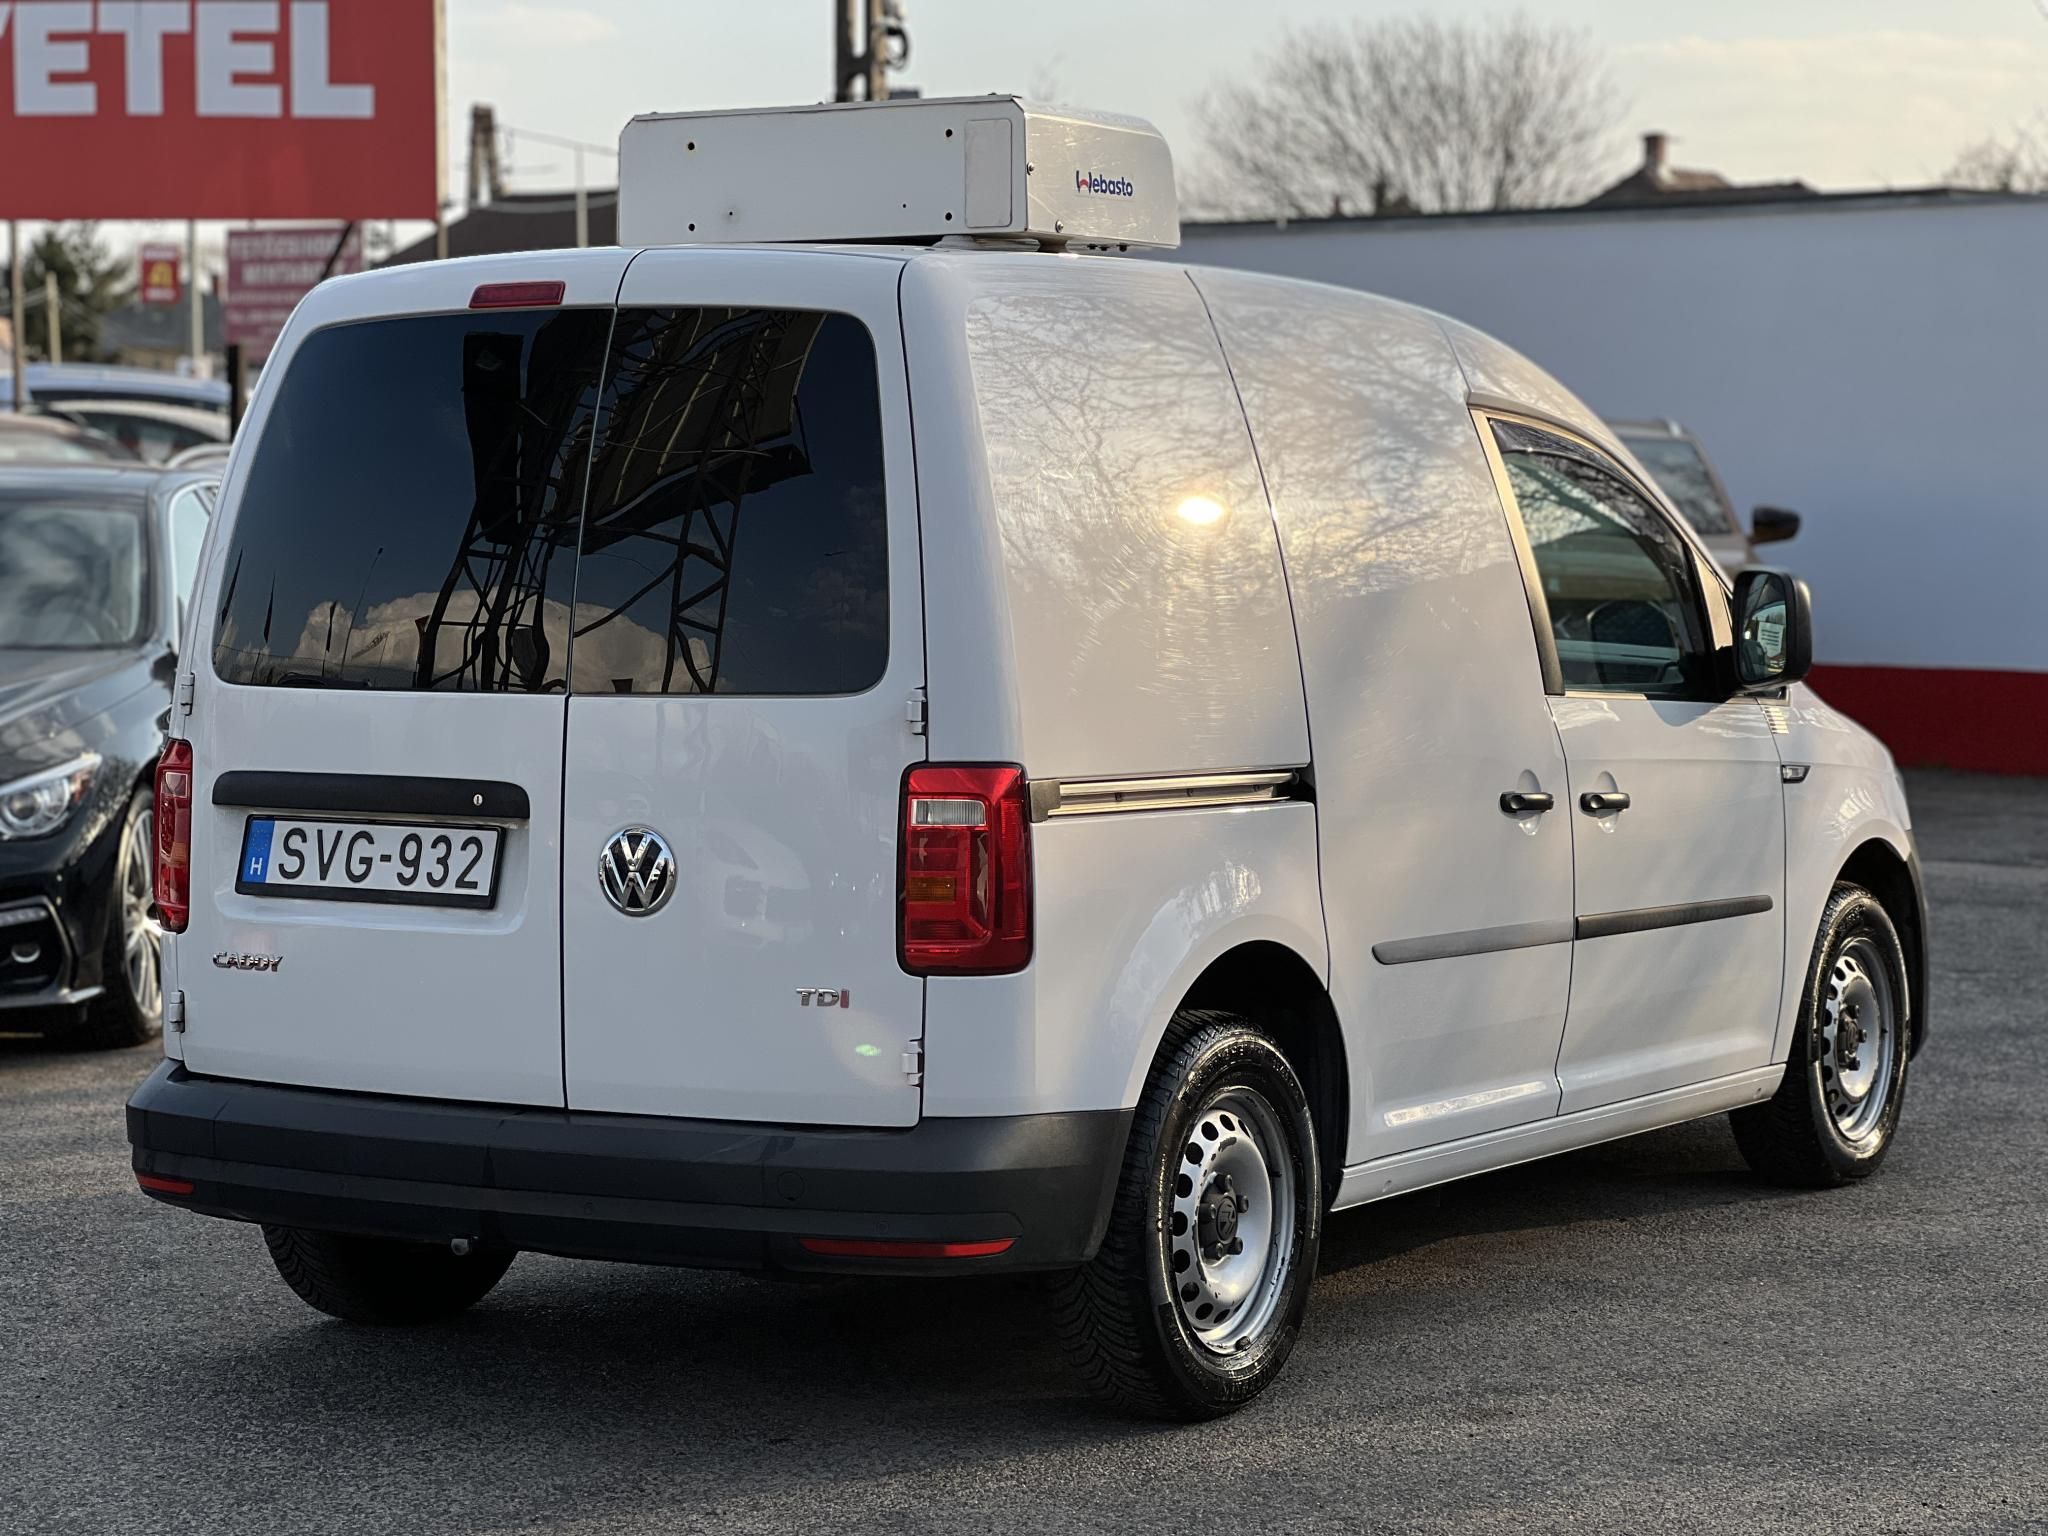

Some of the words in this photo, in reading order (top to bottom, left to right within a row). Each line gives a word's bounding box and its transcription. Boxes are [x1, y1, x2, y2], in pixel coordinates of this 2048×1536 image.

[0, 2, 375, 118] ETEL
[1076, 170, 1133, 196] Webasto
[250, 857, 262, 876] H
[278, 827, 484, 889] SVG-932
[213, 952, 283, 972] CADDY
[796, 988, 850, 1008] TDI
